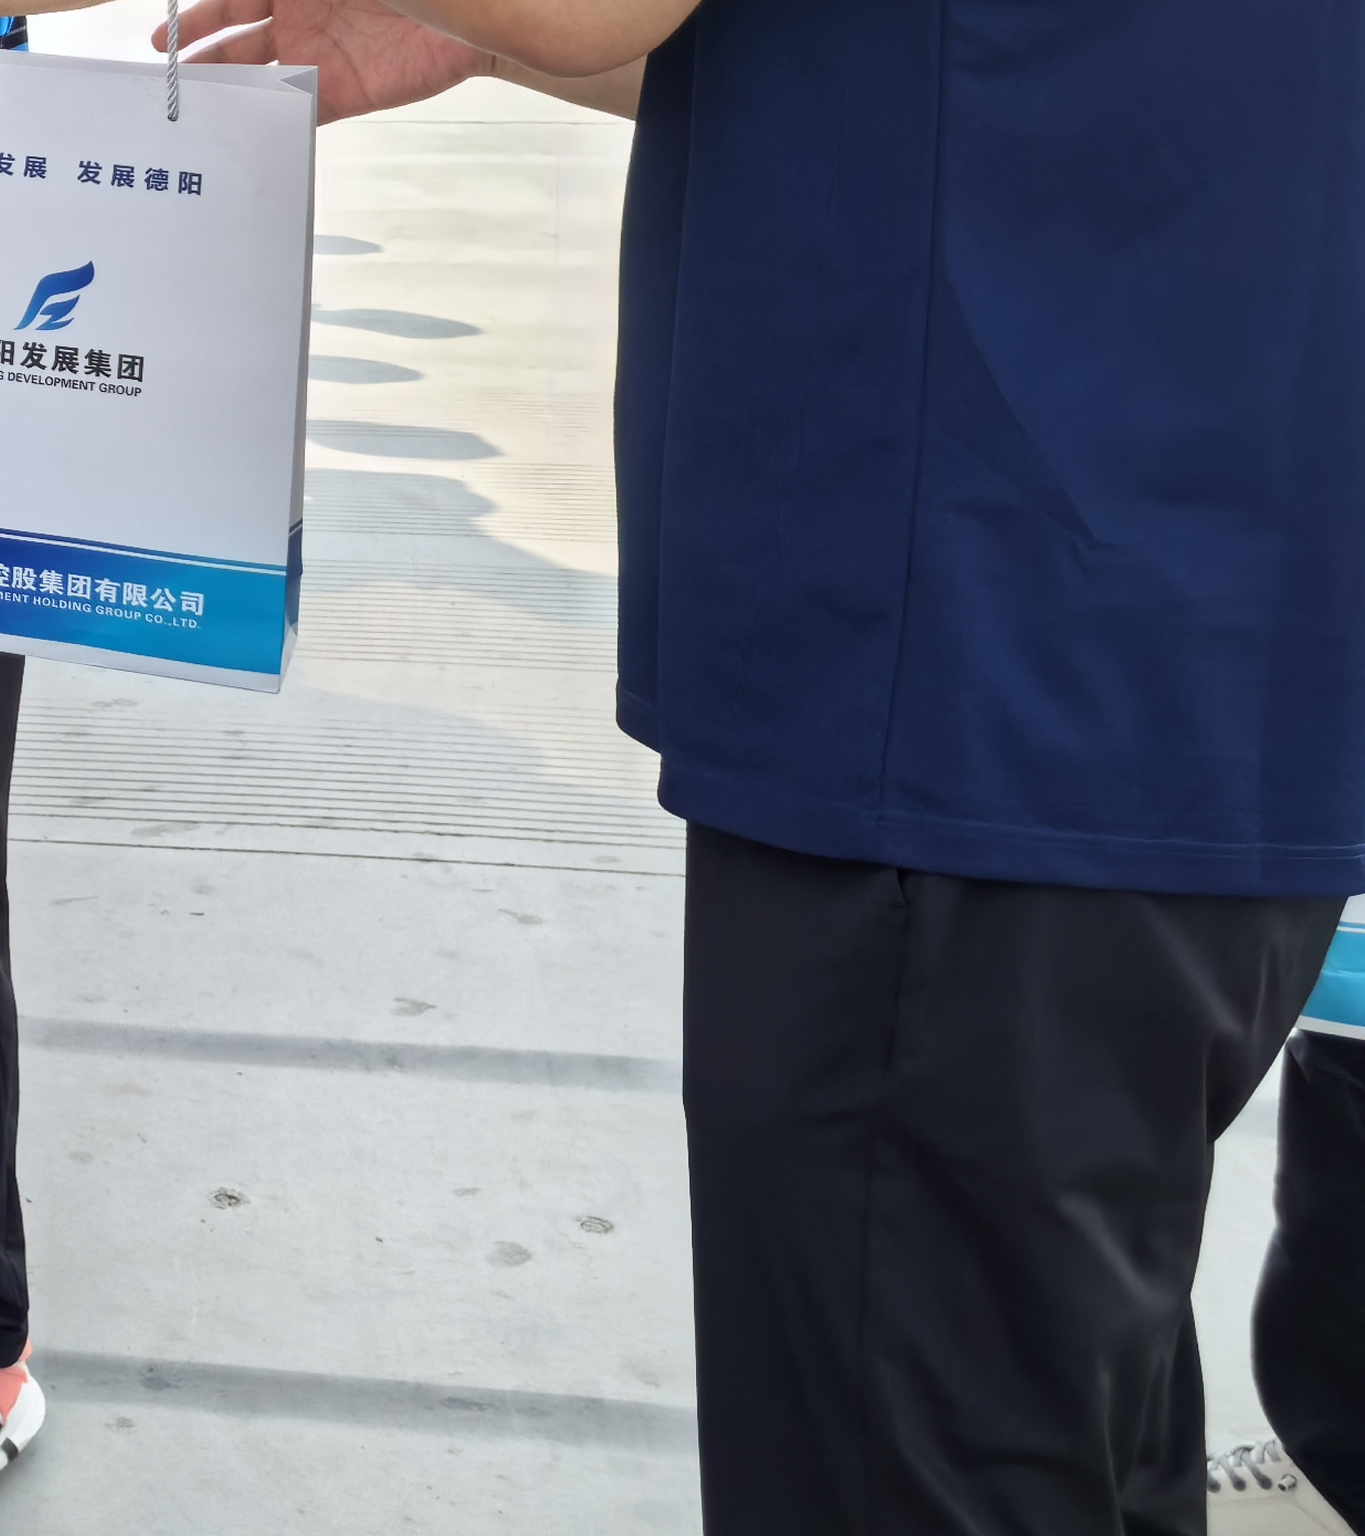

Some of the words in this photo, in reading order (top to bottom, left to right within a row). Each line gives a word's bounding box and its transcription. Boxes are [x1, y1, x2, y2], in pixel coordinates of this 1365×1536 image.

[77, 160, 202, 196] 发展德阳
[7, 372, 96, 392] DEVELOPMENT
[98, 382, 142, 398] GROUP
[32, 596, 92, 613] HOLDING
[95, 605, 142, 621] GROUP
